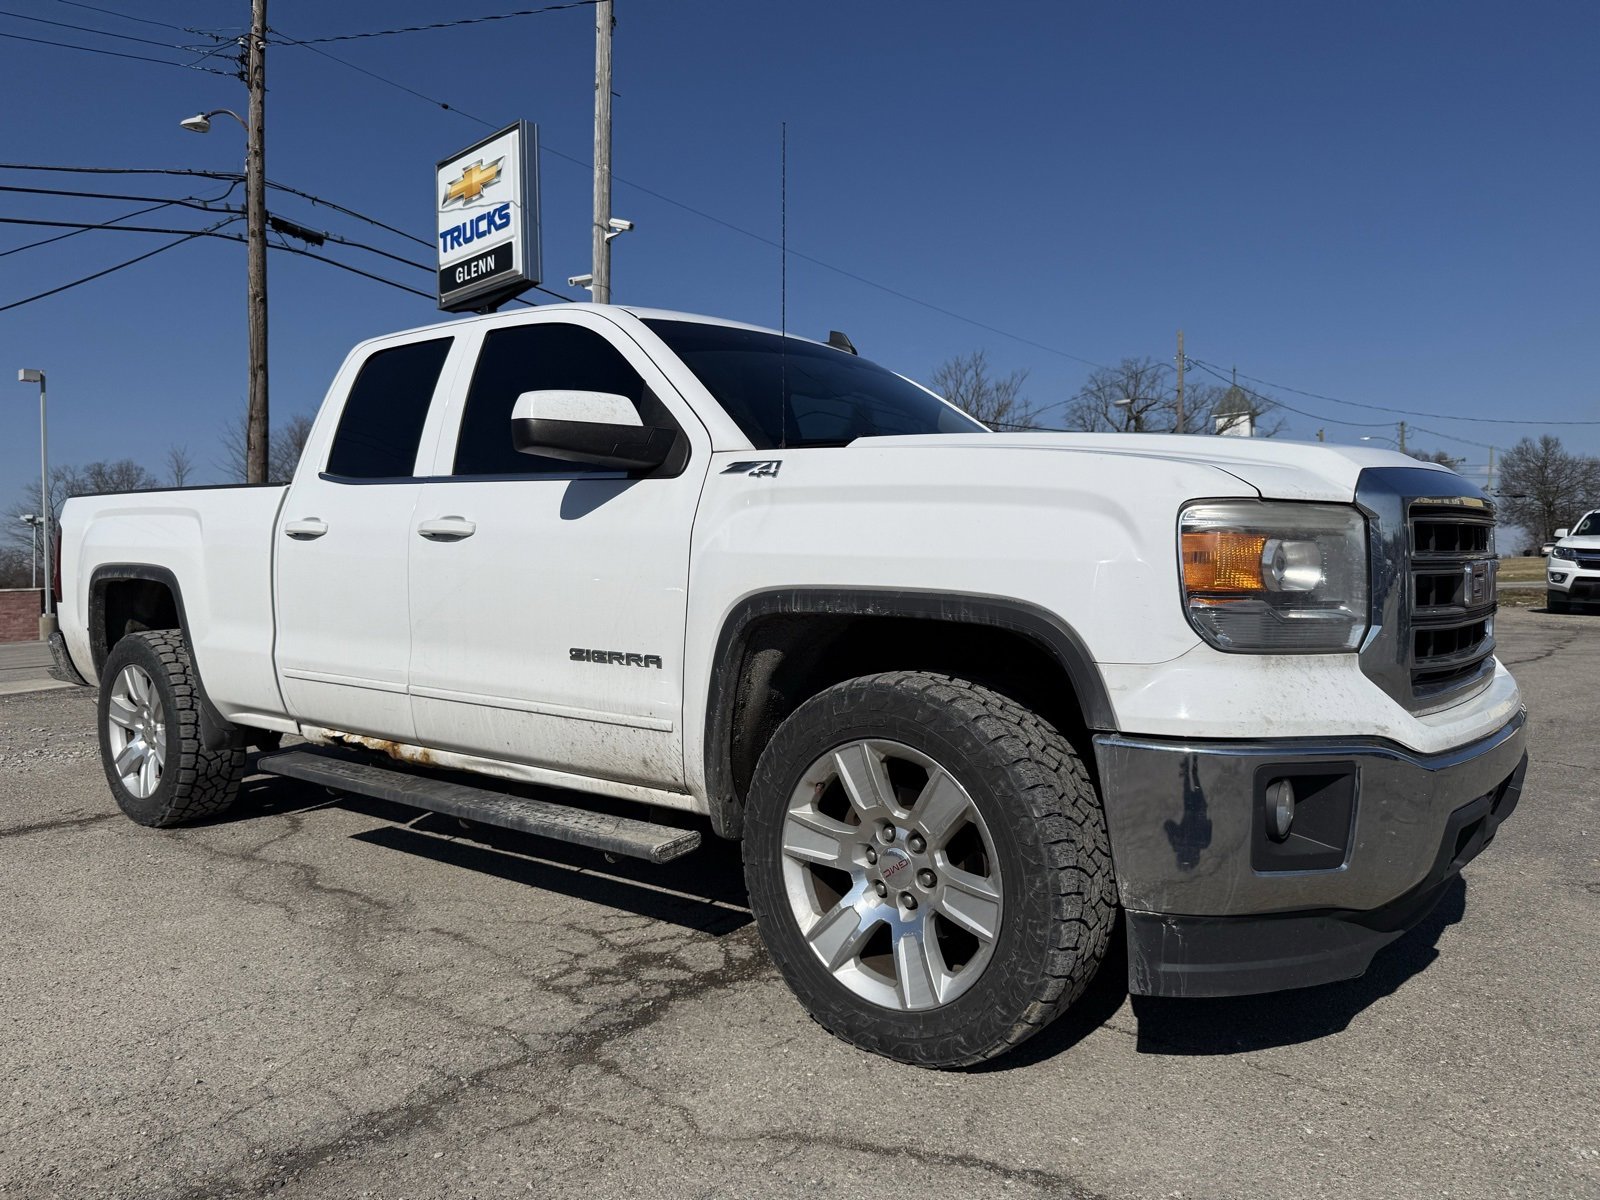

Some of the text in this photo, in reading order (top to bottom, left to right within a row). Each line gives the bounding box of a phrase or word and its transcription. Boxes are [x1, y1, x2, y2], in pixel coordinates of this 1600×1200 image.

[439, 202, 511, 253] TRUCKS
[455, 254, 496, 284] GLENN
[569, 647, 663, 670] SIERRA
[883, 859, 909, 878] GMC
